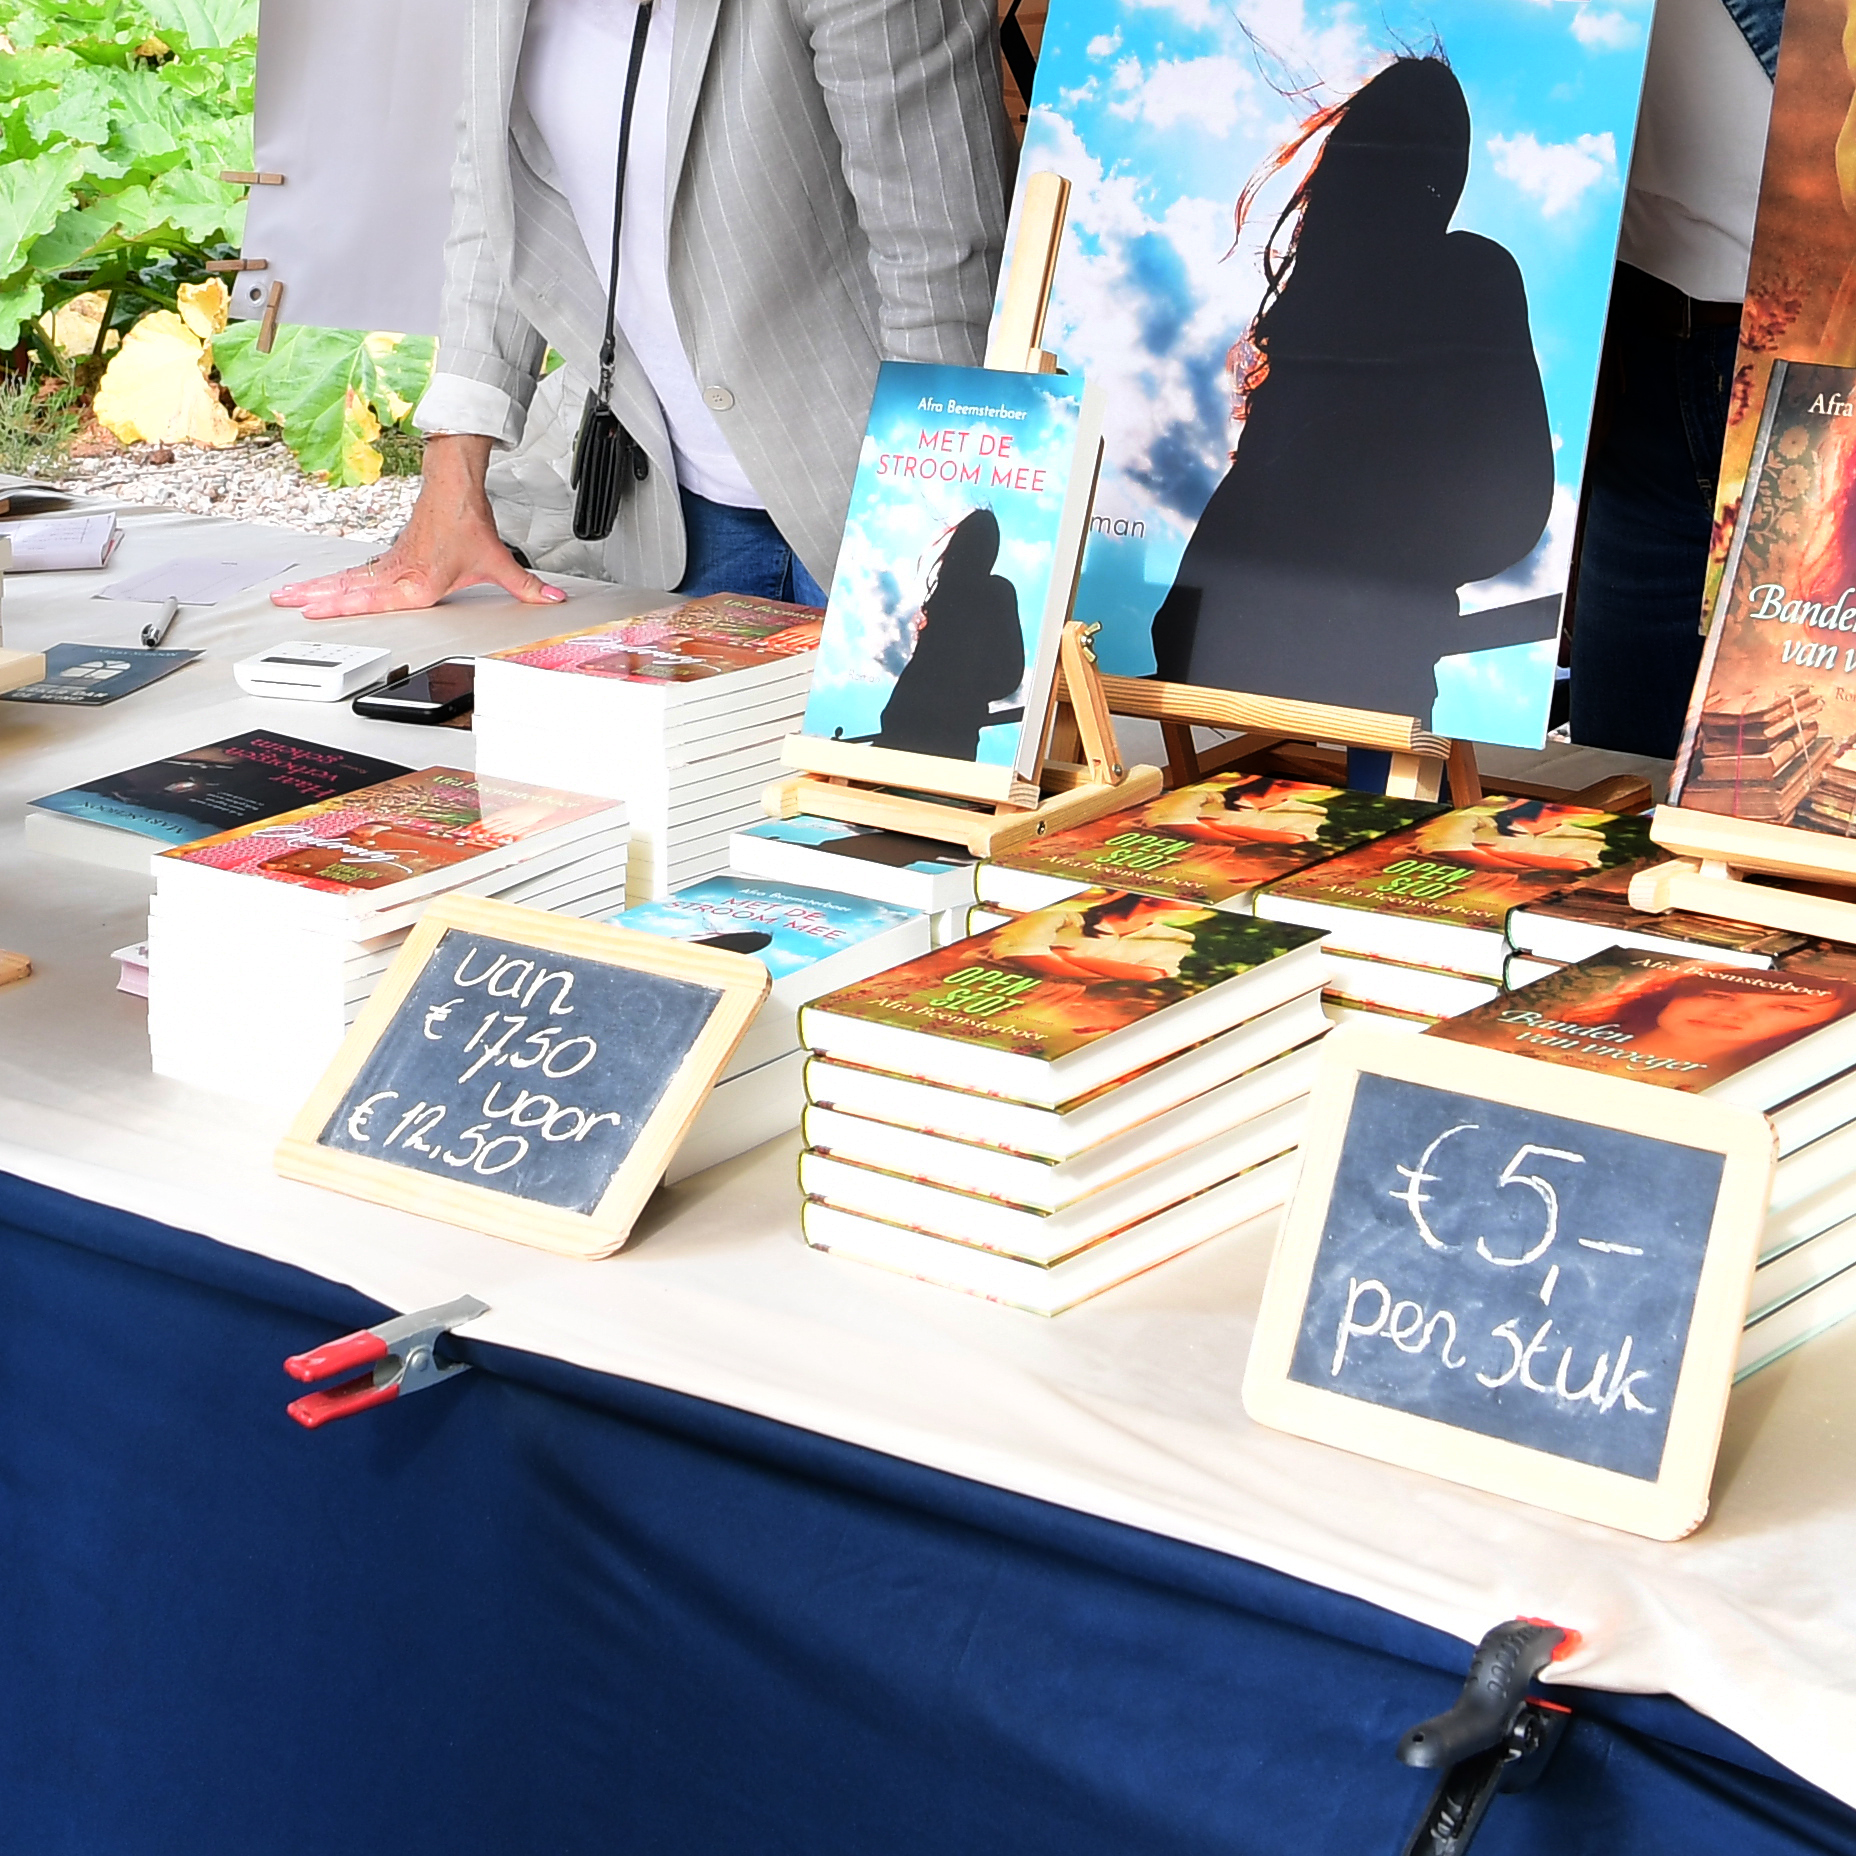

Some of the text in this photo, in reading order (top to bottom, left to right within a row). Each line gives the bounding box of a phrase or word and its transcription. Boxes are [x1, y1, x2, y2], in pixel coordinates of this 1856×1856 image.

[917, 396, 1028, 423] Afra Beemsterboer
[1807, 392, 1853, 418] Afra
[918, 428, 1015, 460] MET DE
[875, 453, 1047, 492] STROOM MEE
[1089, 513, 1146, 540] man
[1780, 637, 1839, 671] van
[1095, 848, 1182, 872] SLOT
[1104, 832, 1196, 856] OPEN
[1382, 859, 1476, 884] OPEN
[1319, 884, 1362, 898] Afra
[1365, 891, 1499, 919] Beemsterboer
[1376, 877, 1467, 900] SLOT
[664, 900, 848, 942] STROOM MEE
[720, 896, 827, 923] MET DE
[452, 946, 574, 1015] van
[943, 966, 1043, 996] OPEN
[1630, 958, 1834, 997] Afra Beemsterboer
[865, 998, 1049, 1041] Afra Beemsterboer
[929, 988, 1026, 1018] SLOT
[1497, 1009, 1635, 1044] Banden
[1515, 1031, 1580, 1051] van
[1581, 1042, 1708, 1073] vroeger
[482, 1081, 621, 1142] voor
[1475, 1320, 1658, 1415] stuk
